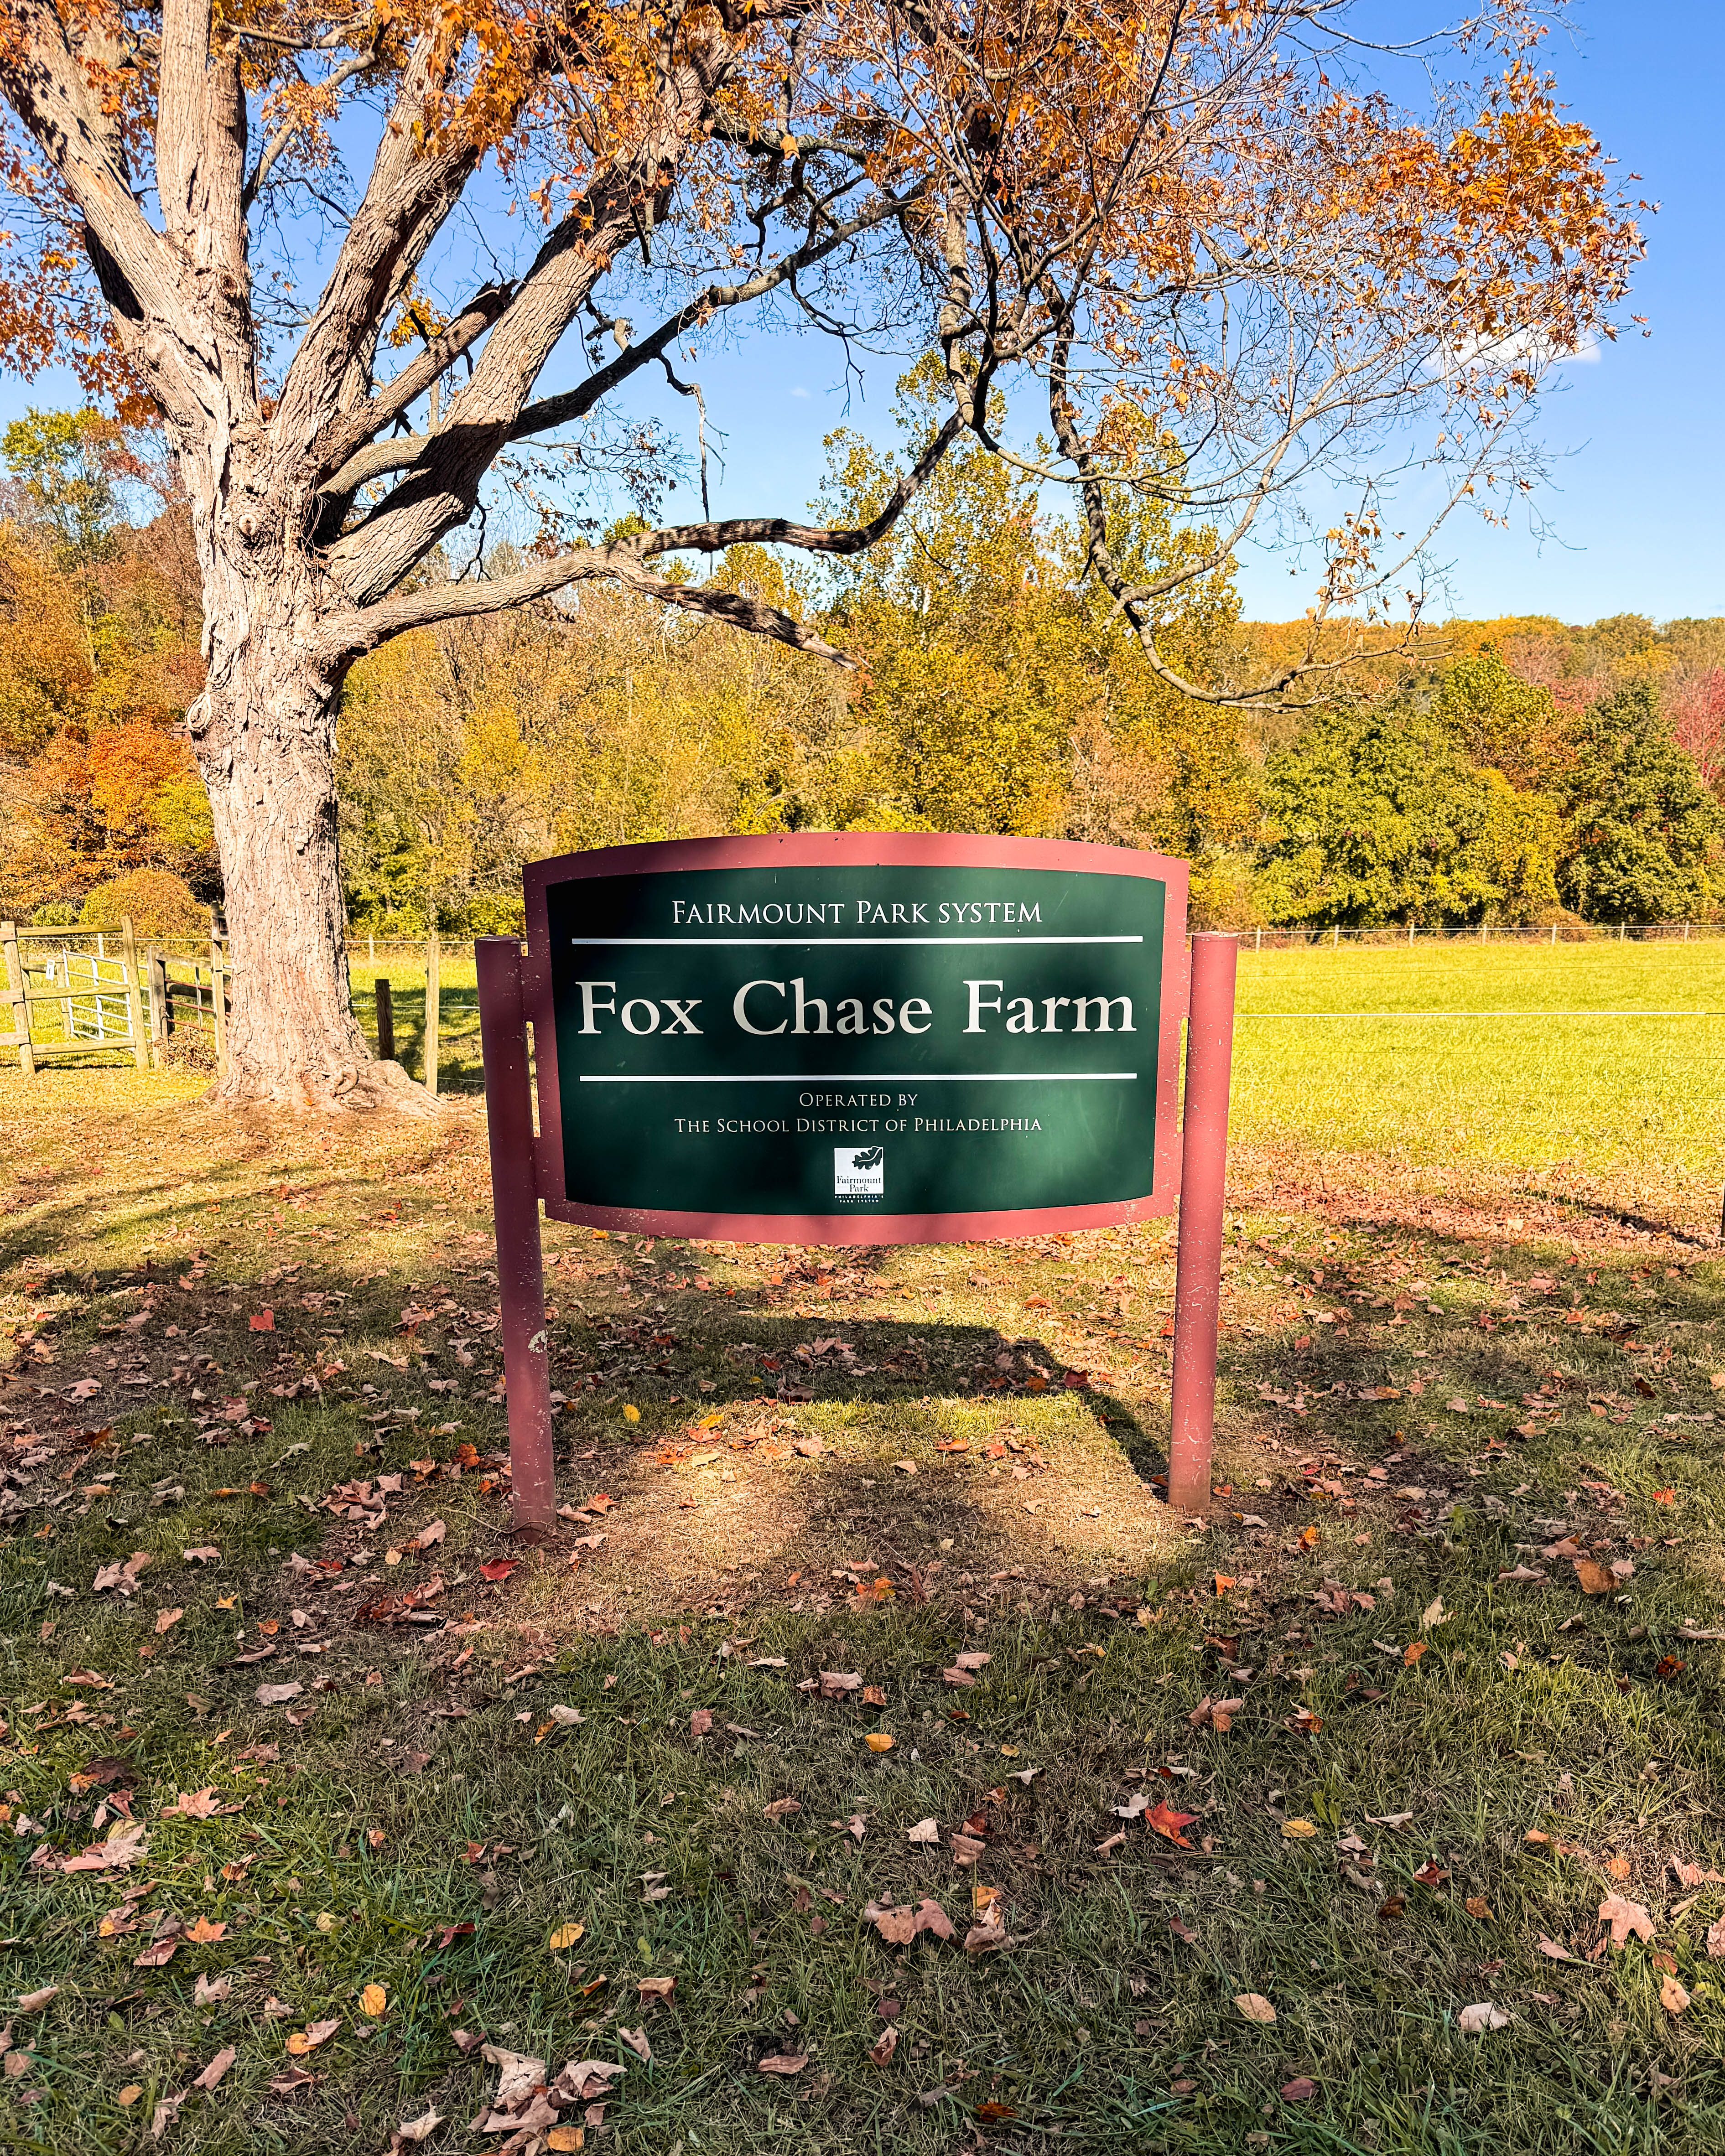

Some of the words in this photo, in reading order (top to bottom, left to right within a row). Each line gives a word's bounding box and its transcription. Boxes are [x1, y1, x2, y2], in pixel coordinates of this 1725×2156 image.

[671, 901, 845, 924] FAIRMOUNT
[856, 900, 930, 924] PARK
[938, 901, 1043, 923] SYSTEM
[575, 981, 704, 1035] Fox
[733, 977, 933, 1035] Chase
[962, 980, 1137, 1033] Farm
[799, 1093, 891, 1107] OPERATED
[899, 1094, 918, 1106] BY
[674, 1119, 710, 1132] THE
[717, 1118, 789, 1133] SCHOOL
[796, 1118, 879, 1132] DISTRICT
[885, 1119, 907, 1132] OF
[914, 1118, 1043, 1132] PHILADELPHIA
